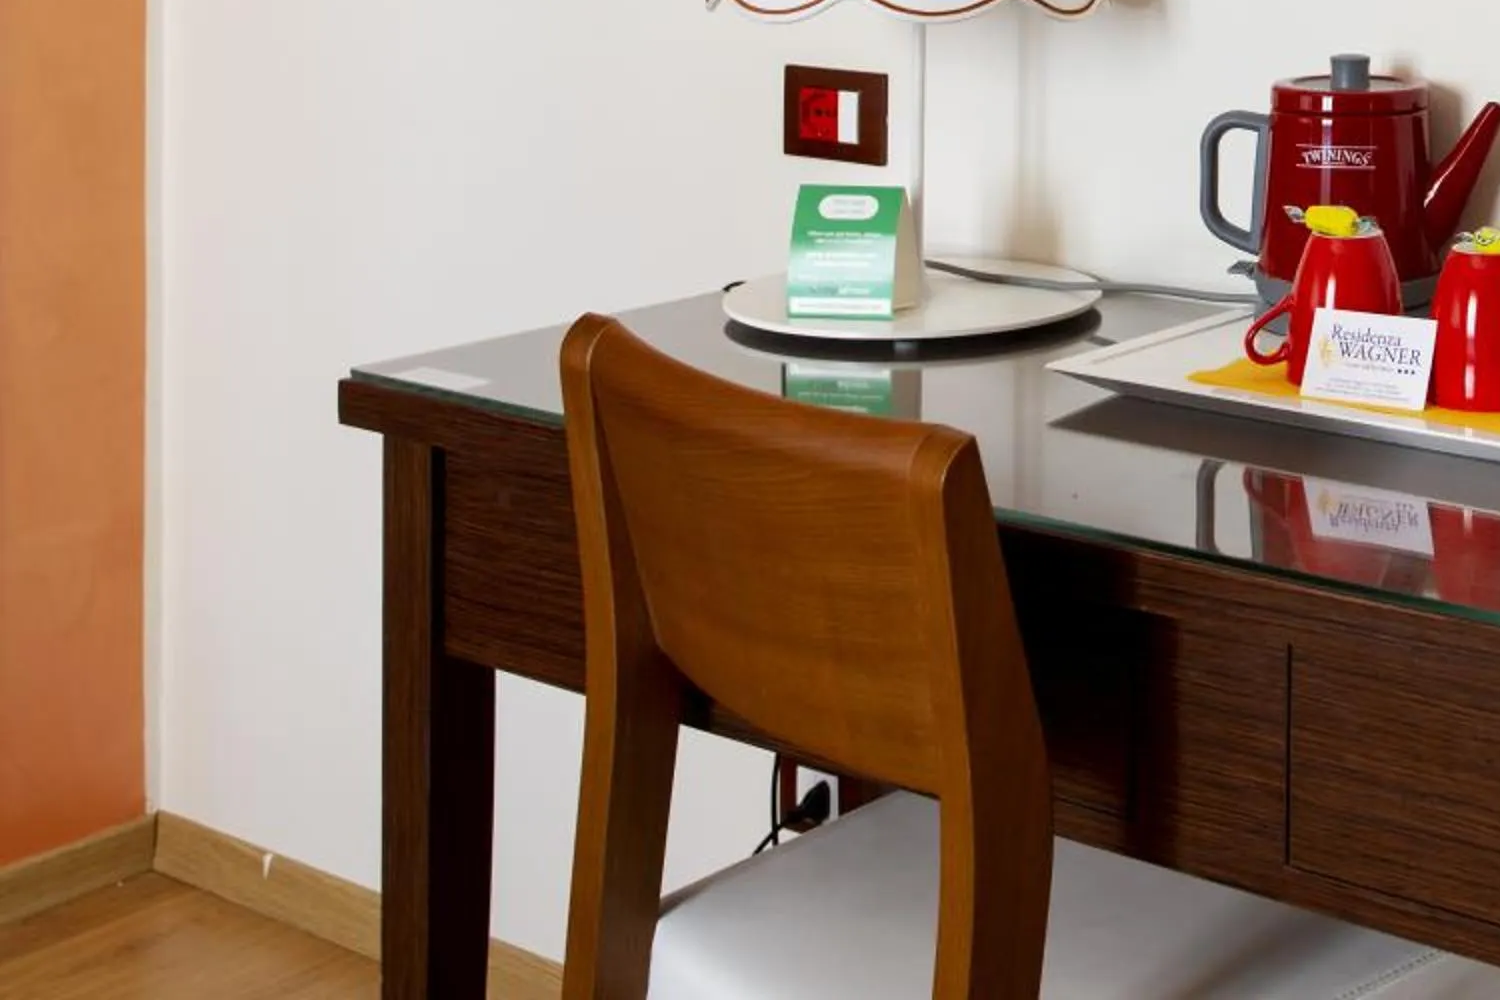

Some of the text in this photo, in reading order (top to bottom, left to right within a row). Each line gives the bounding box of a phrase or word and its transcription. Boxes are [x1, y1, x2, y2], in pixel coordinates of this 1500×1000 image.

[1302, 149, 1371, 166] TWININGS
[1331, 323, 1401, 347] Residenza
[1339, 341, 1422, 366] WAGNER
